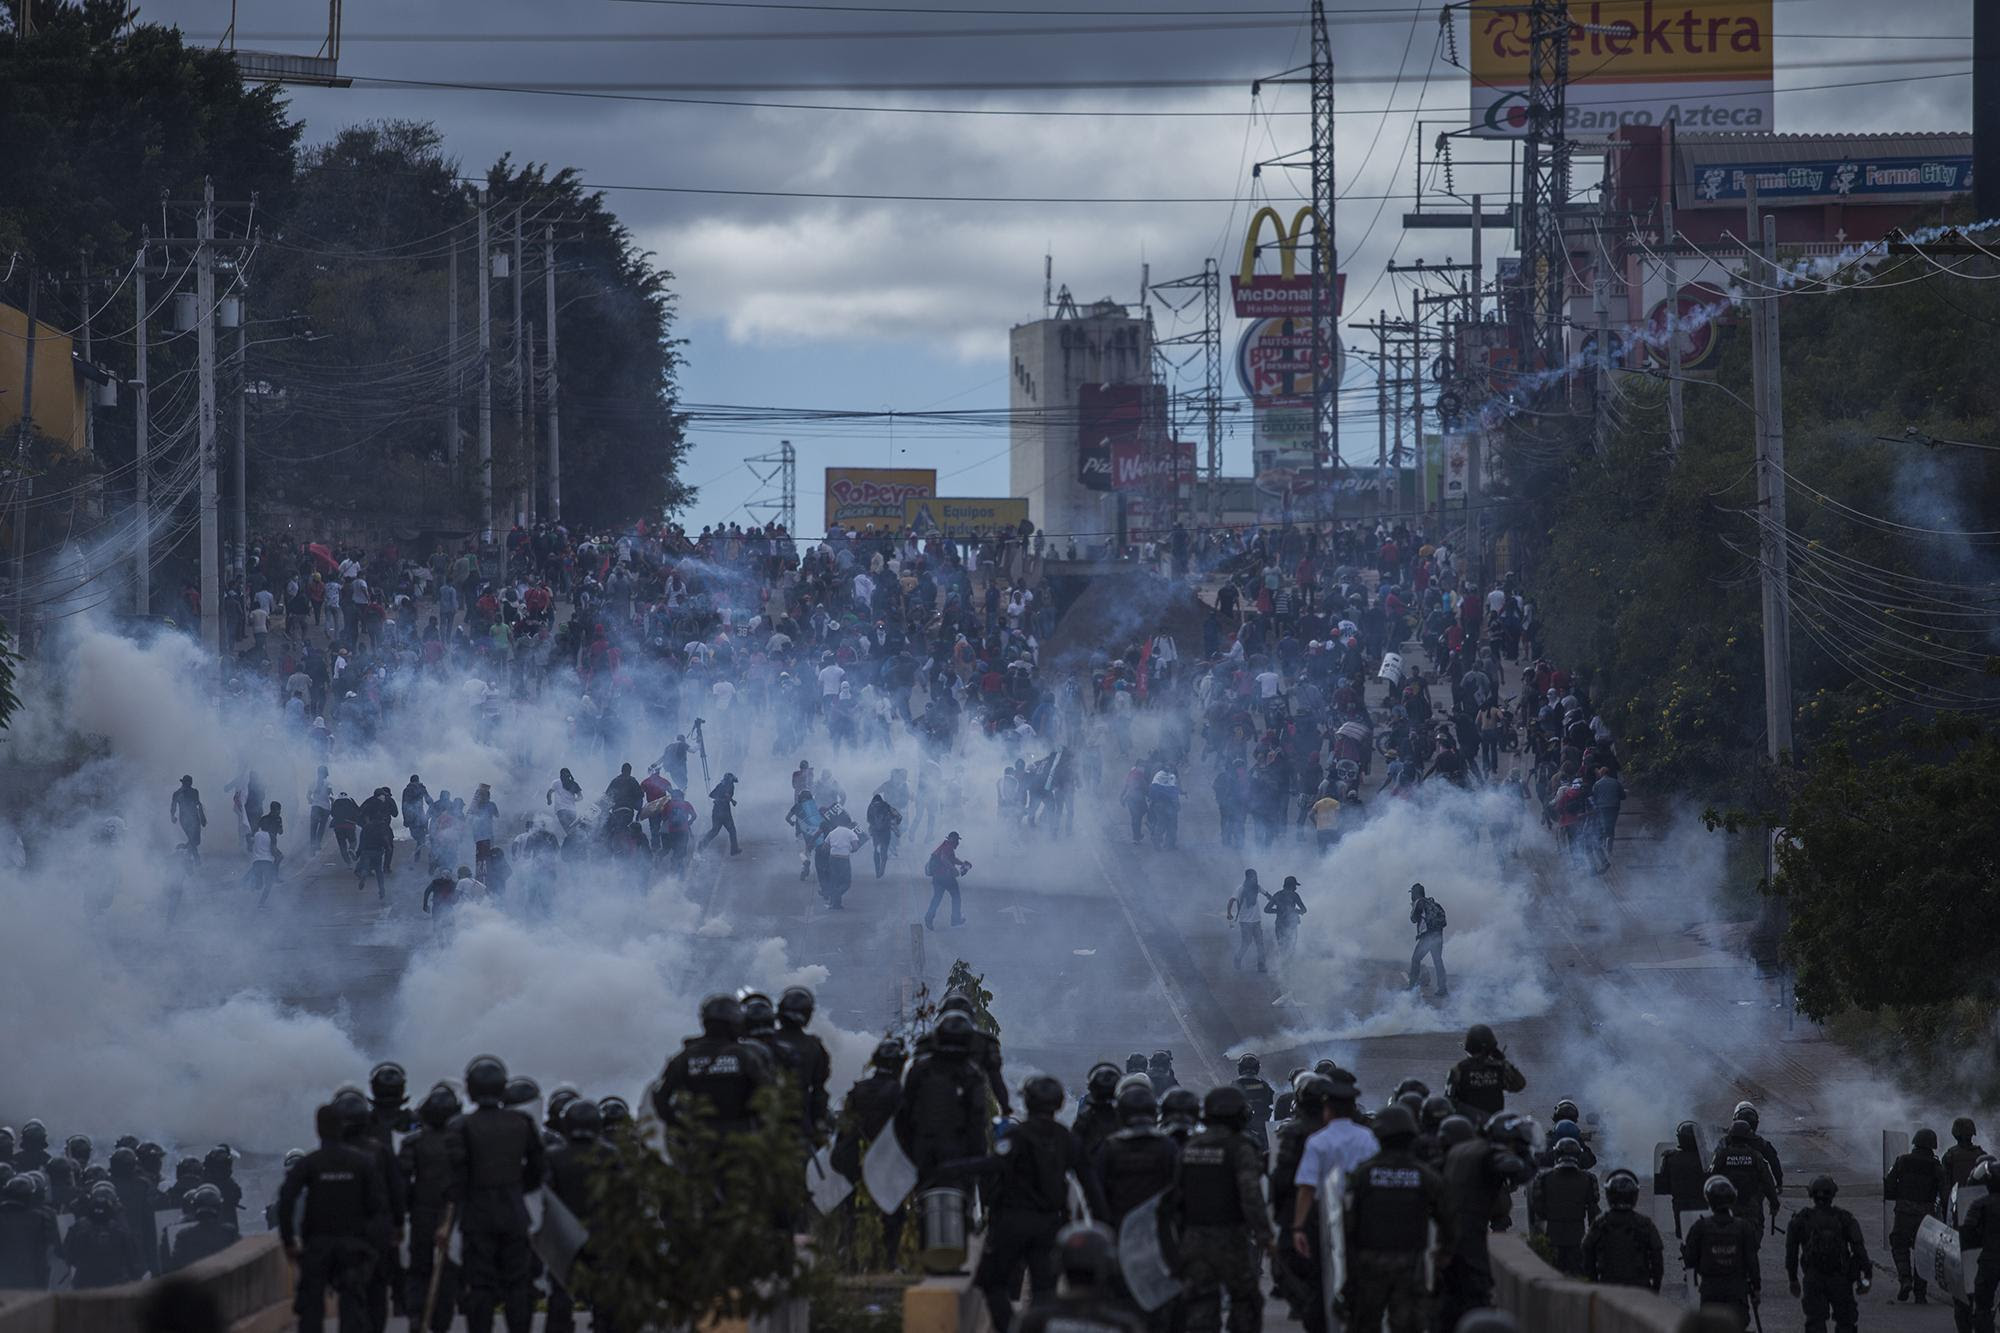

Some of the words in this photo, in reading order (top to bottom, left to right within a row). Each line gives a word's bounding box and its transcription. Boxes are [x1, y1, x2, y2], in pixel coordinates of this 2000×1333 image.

[1563, 106, 1652, 128] Banco
[1661, 105, 1763, 127] Azteca
[1733, 168, 1824, 192] FrmaCity
[1867, 164, 1957, 188] FarmaCity
[943, 505, 995, 521] Equipos
